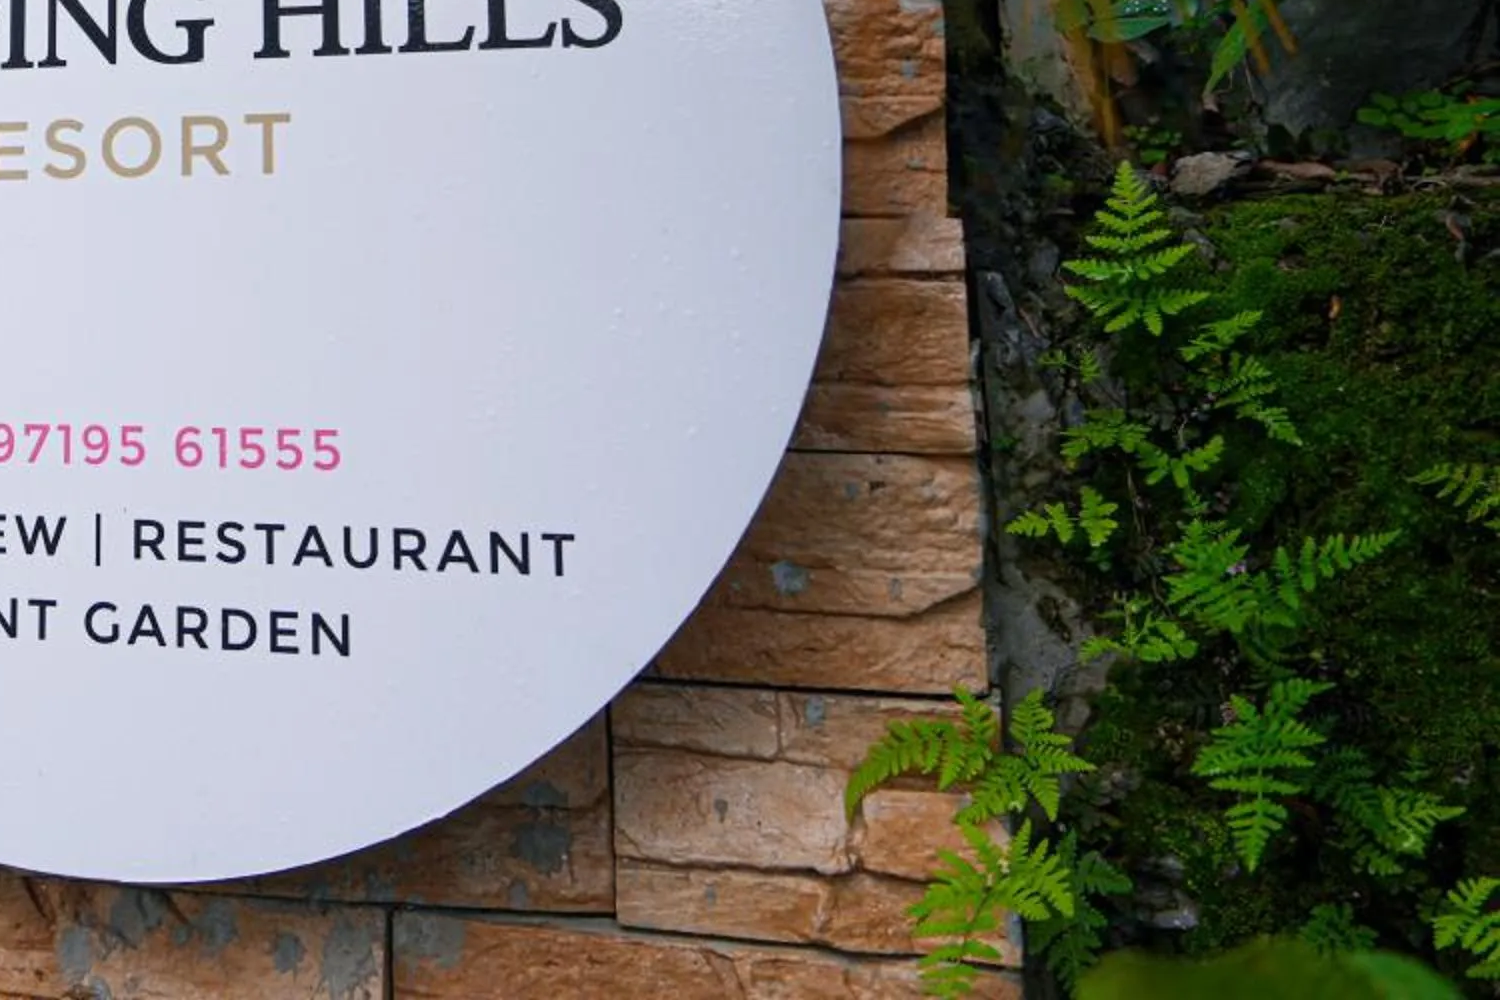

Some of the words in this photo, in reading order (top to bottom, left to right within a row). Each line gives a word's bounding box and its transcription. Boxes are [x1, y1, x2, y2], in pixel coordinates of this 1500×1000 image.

[175, 426, 341, 471] 61555
[133, 518, 576, 577] RESTAURANT
[83, 600, 351, 658] GARDEN
